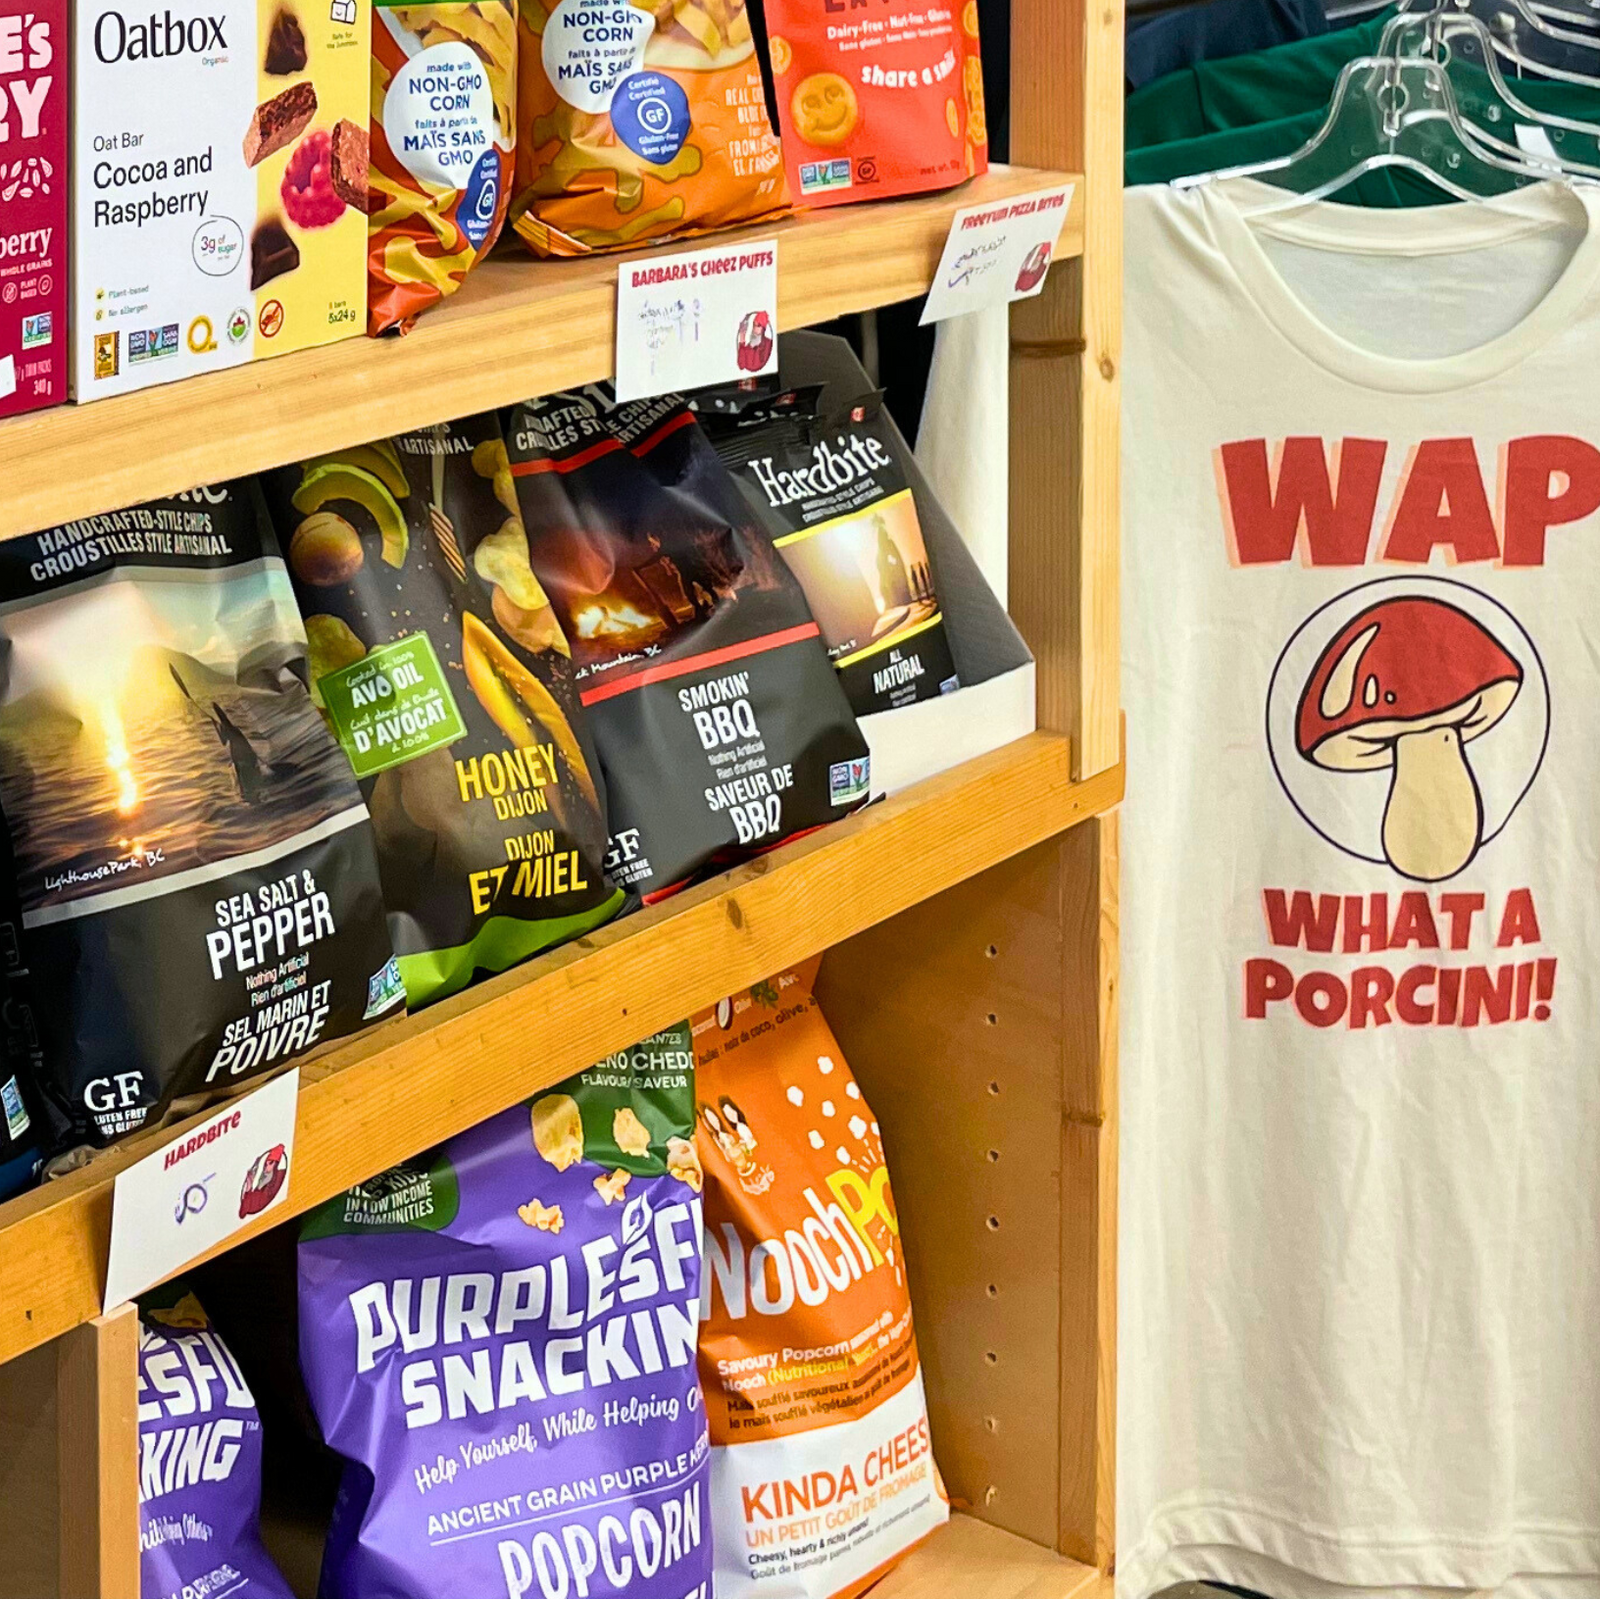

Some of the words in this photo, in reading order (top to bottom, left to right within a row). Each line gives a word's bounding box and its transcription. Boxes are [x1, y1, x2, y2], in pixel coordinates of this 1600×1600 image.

[94, 10, 228, 64] Oatbox
[429, 94, 470, 110] CORN
[93, 136, 118, 152] Oat
[122, 133, 144, 148] Bar
[94, 162, 167, 190] Cocoa
[174, 146, 212, 177] and
[94, 190, 208, 228] Raspberry
[739, 251, 773, 270] PUFFS
[749, 434, 889, 508] Hardbite
[1213, 434, 1600, 569] WAP
[693, 701, 759, 750] BBQ
[455, 743, 558, 802] HONEY
[493, 788, 547, 821] DIJON
[215, 893, 256, 926] SEA
[259, 874, 299, 913] SALT
[302, 869, 316, 894] &
[512, 850, 587, 899] MIEL
[205, 892, 335, 979] PEPPER
[1262, 889, 1485, 954] WHAT
[1497, 887, 1542, 949] A
[1243, 957, 1557, 1030] PORCINI!
[206, 1006, 329, 1083] POIVRE
[414, 1454, 457, 1494] Help
[544, 1406, 597, 1452] While
[603, 1391, 682, 1428] Helping
[428, 1493, 521, 1536] ANCIENT
[527, 1476, 597, 1510] GRAIN
[601, 1454, 688, 1491] PURPLE
[742, 1465, 858, 1523] KINDA
[498, 1489, 700, 1599] POPCORN
